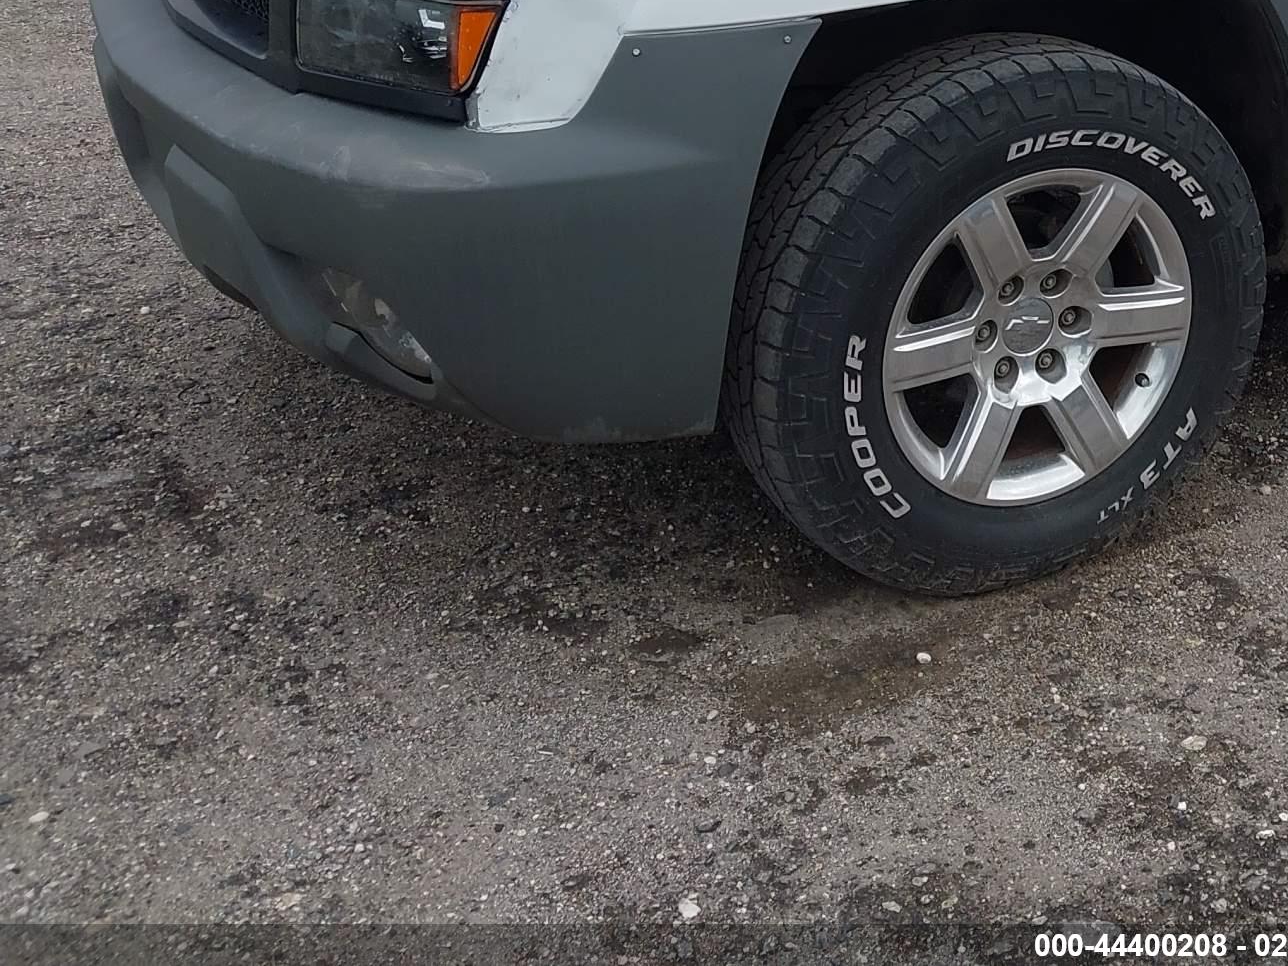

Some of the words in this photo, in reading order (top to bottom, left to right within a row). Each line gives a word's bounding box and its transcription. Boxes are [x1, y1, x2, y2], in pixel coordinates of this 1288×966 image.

[1006, 129, 1216, 221] DISCOVERER
[842, 334, 912, 520] COOPER
[1139, 406, 1198, 491] AT3
[1096, 486, 1135, 525] XLT
